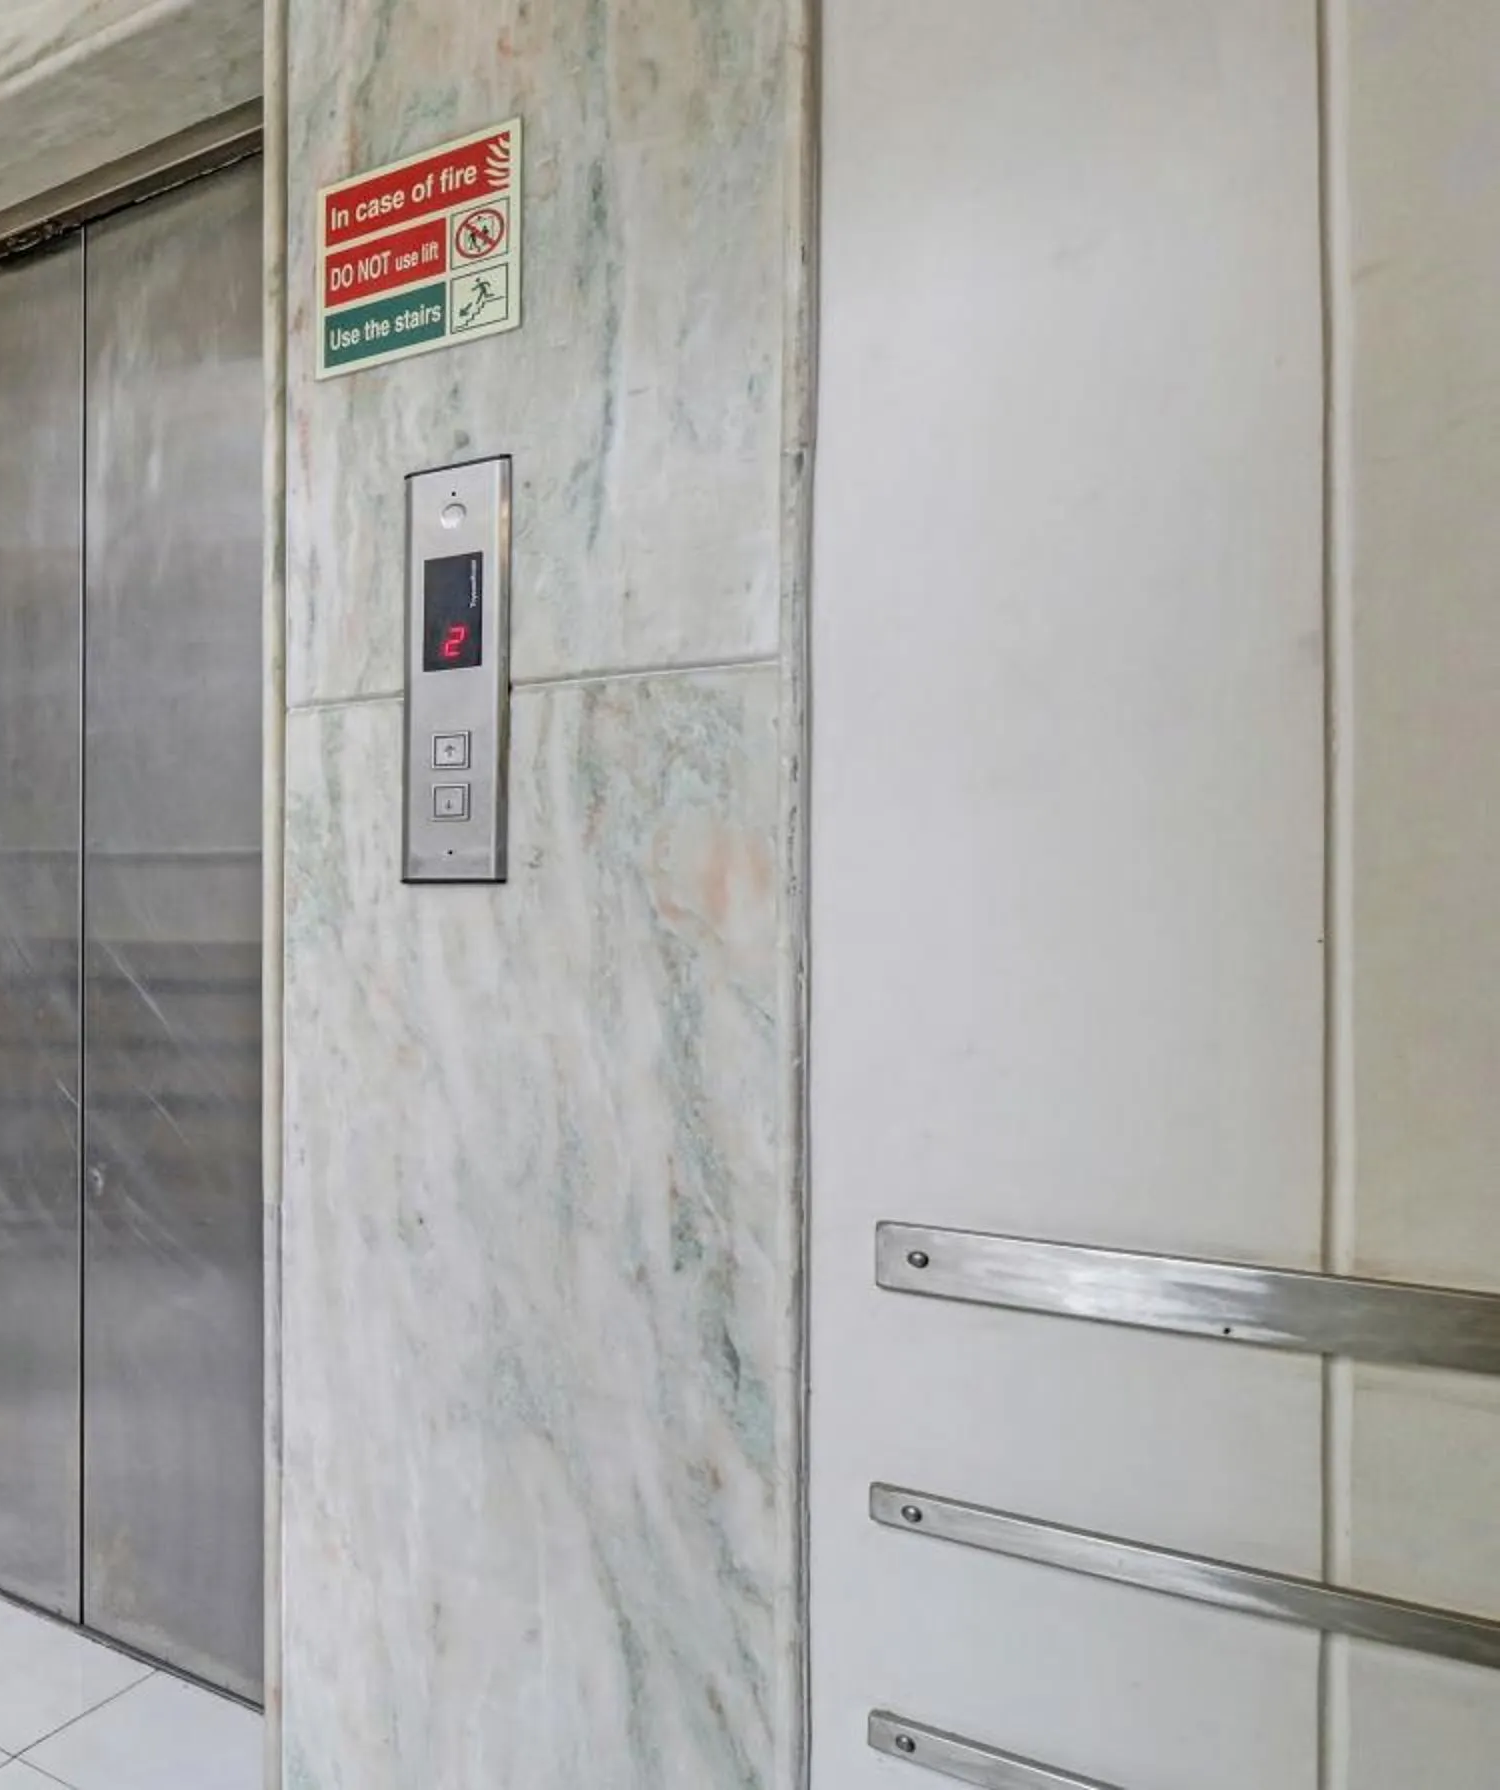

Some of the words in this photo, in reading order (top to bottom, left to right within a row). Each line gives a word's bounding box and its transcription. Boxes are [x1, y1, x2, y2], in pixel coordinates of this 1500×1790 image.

[331, 207, 349, 231] In
[355, 190, 405, 222] case
[411, 175, 434, 204] of
[439, 164, 478, 194] fire
[330, 263, 354, 291] DO
[357, 251, 392, 278] NOT
[395, 252, 419, 271] use
[421, 240, 440, 264] lift
[329, 326, 361, 351] Use
[364, 317, 391, 340] the
[394, 302, 442, 332] stairs
[443, 625, 466, 657] 2
